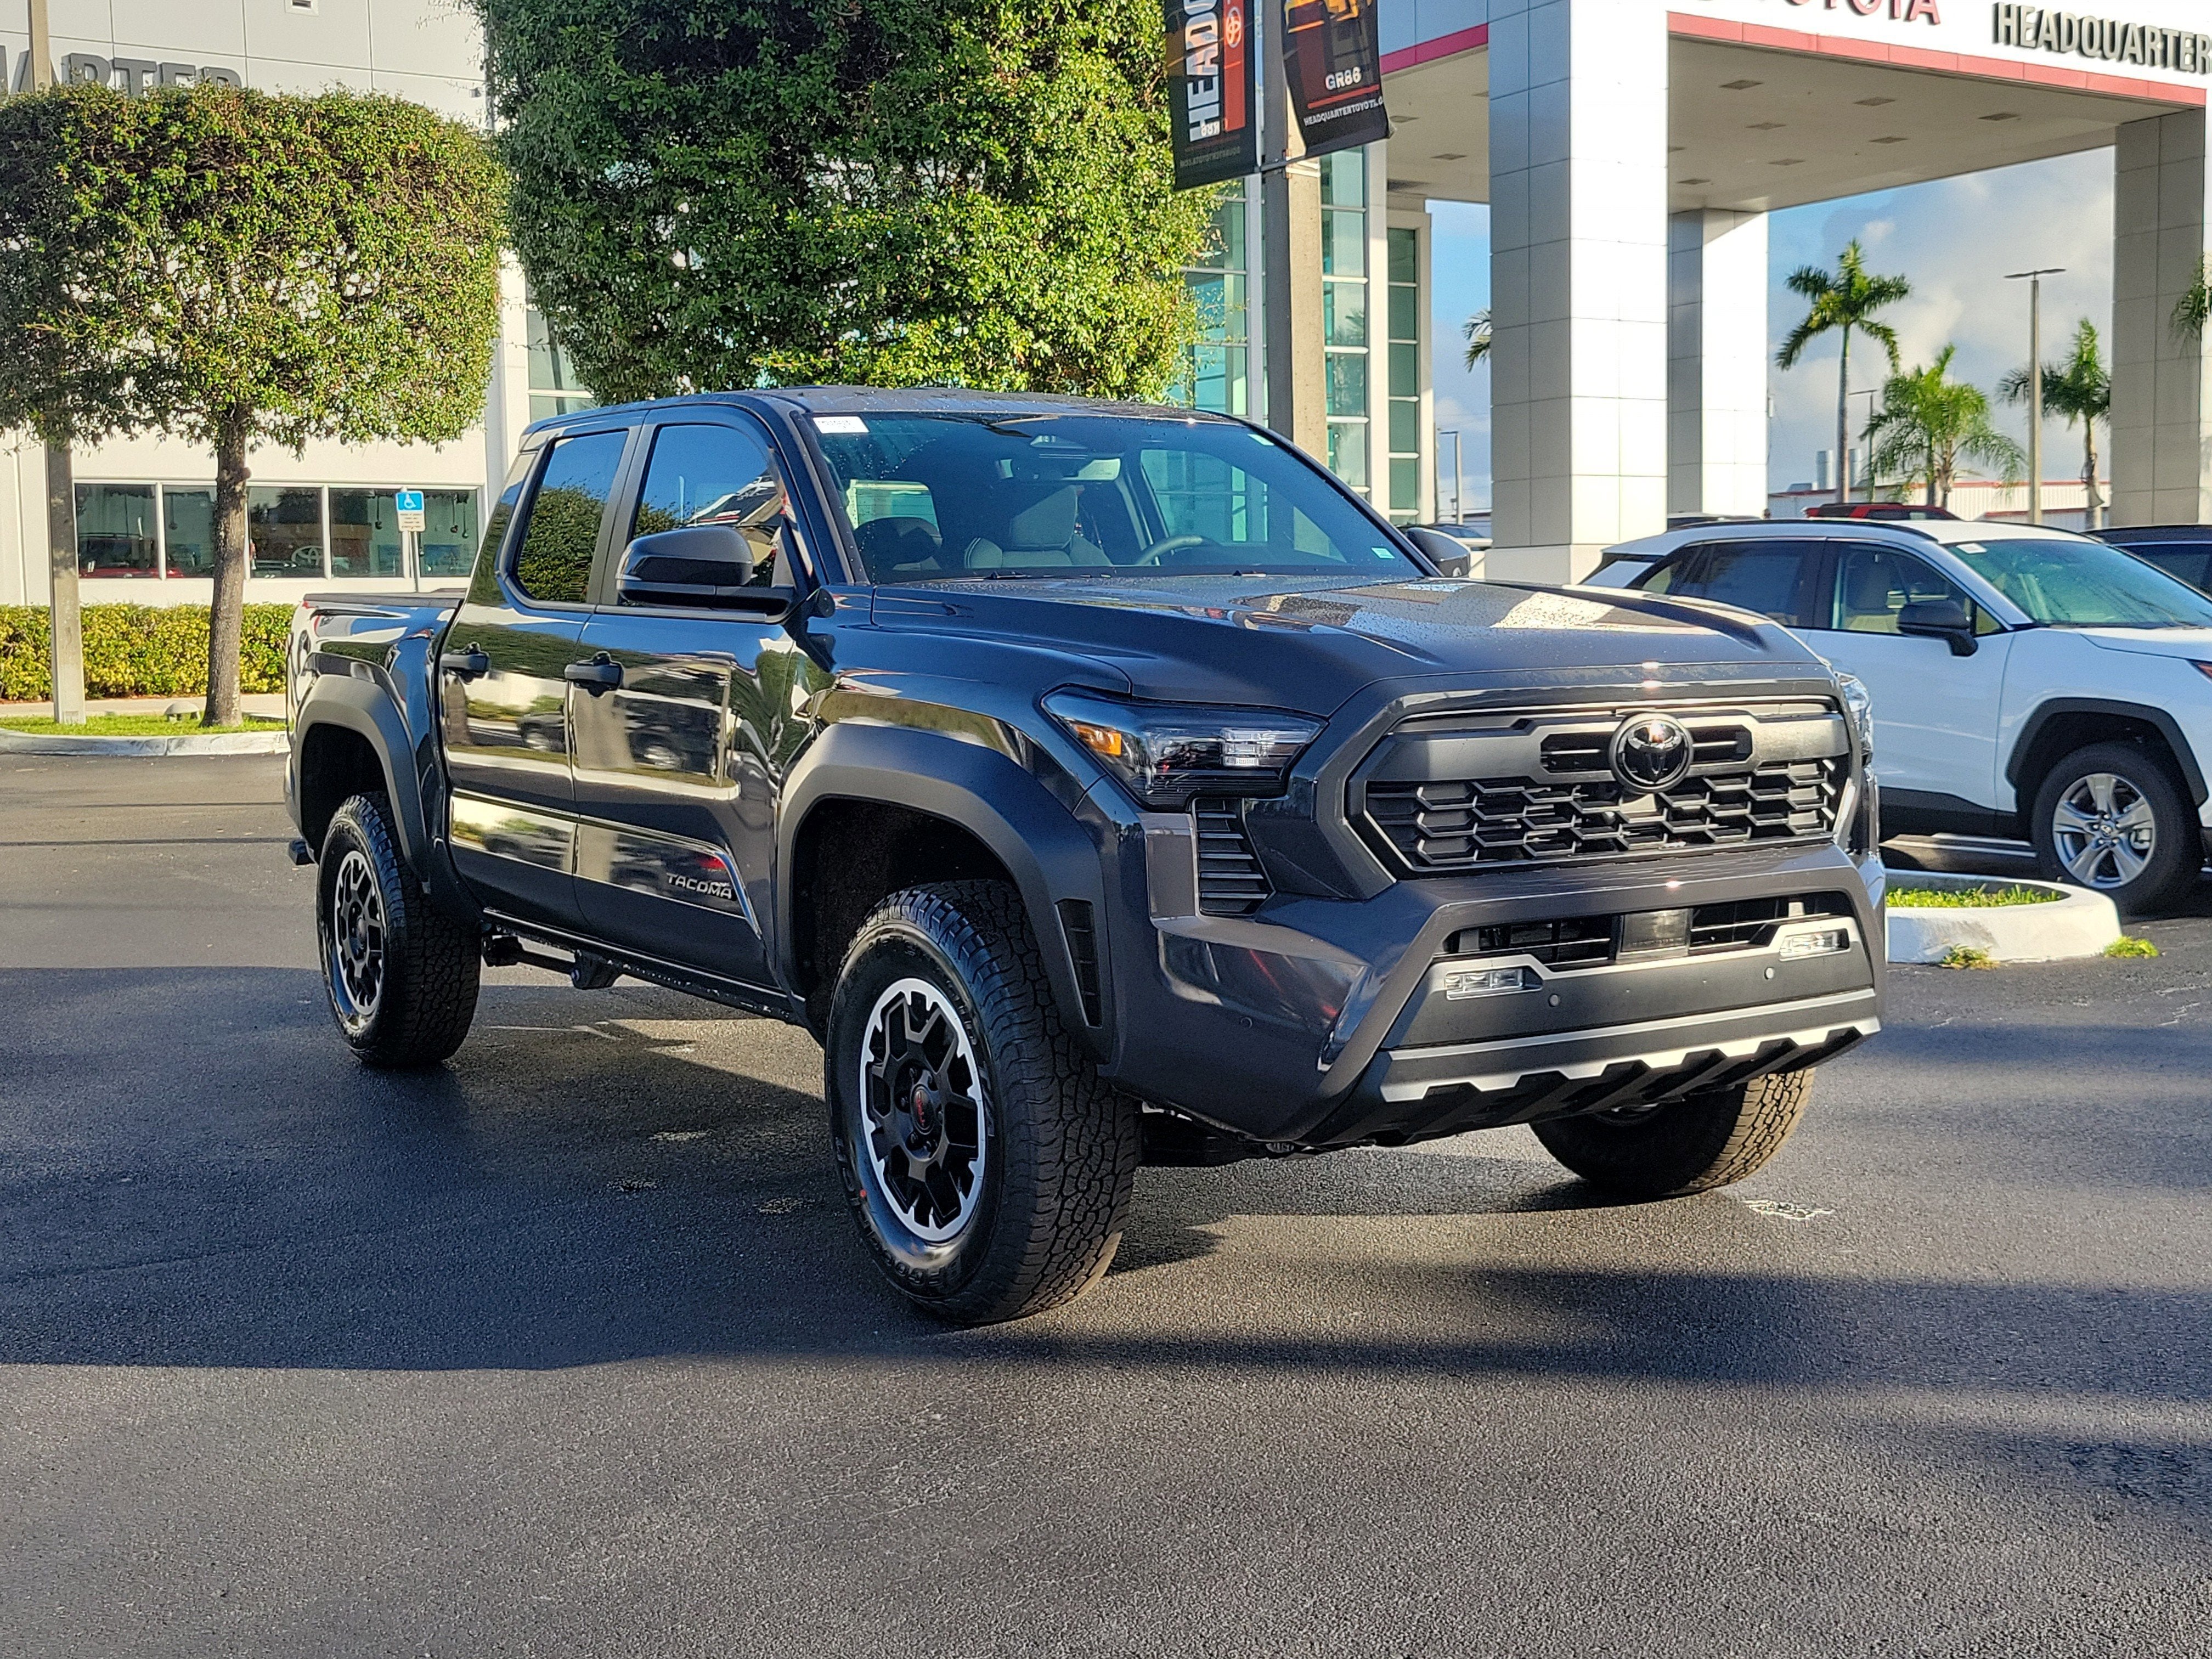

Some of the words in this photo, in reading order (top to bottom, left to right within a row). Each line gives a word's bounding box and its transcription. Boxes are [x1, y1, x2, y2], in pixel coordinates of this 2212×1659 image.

[1993, 2, 2211, 74] HEADQUARTER
[1325, 66, 1362, 91] GR86
[666, 872, 732, 899] TACOMA
